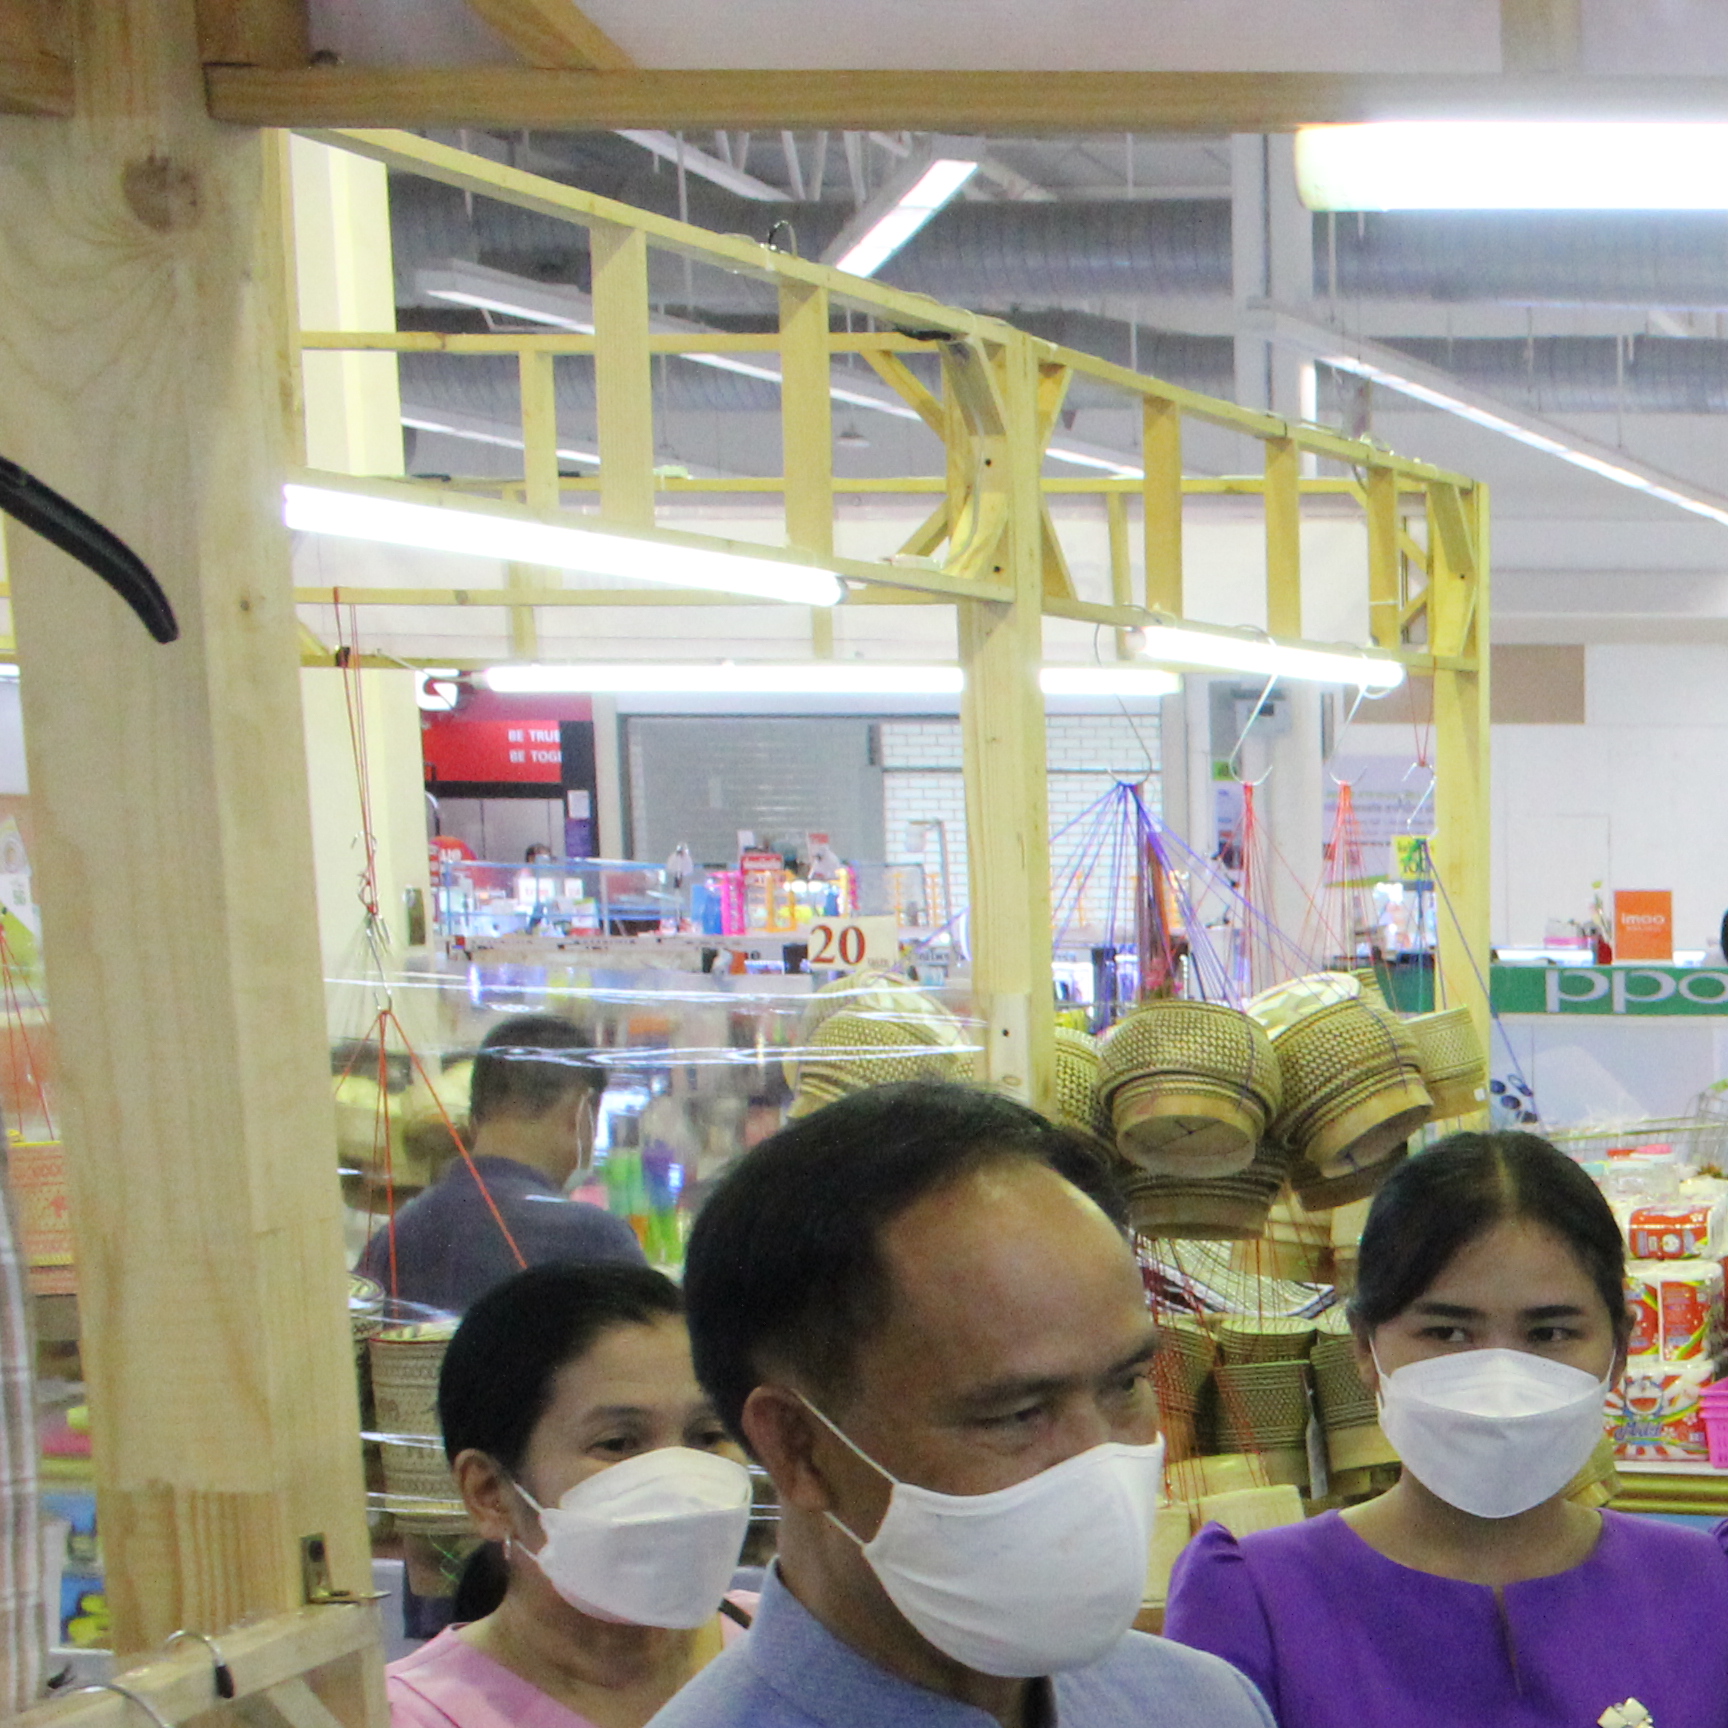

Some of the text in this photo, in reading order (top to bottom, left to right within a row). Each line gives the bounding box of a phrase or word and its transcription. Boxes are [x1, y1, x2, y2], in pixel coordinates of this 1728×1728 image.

[508, 729, 524, 742] BE
[509, 750, 525, 763] BE
[811, 925, 866, 965] 20
